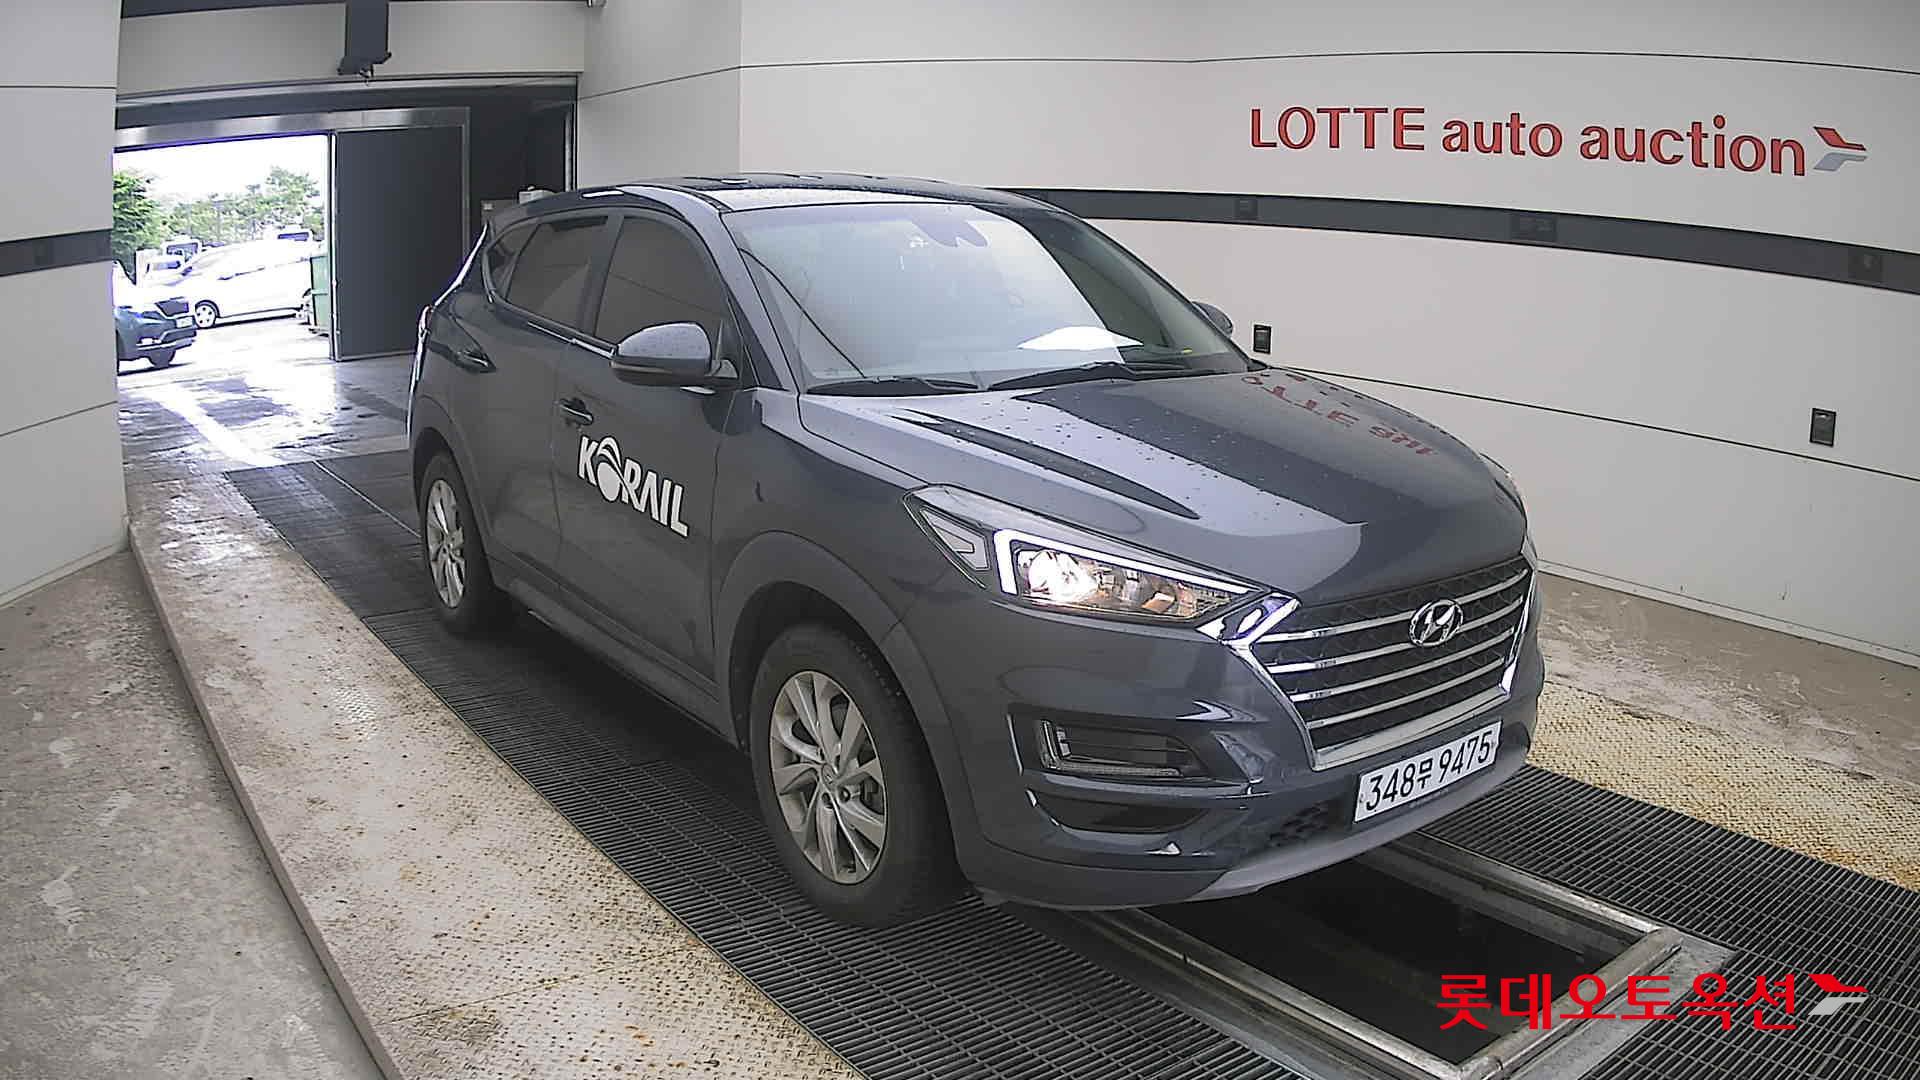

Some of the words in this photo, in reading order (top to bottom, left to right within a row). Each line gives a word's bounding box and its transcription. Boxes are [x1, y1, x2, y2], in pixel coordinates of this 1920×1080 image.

[1250, 106, 1426, 151] LOTTE
[1441, 112, 1563, 159] auto
[1579, 114, 1806, 177] auction
[577, 434, 689, 538] KORAIL
